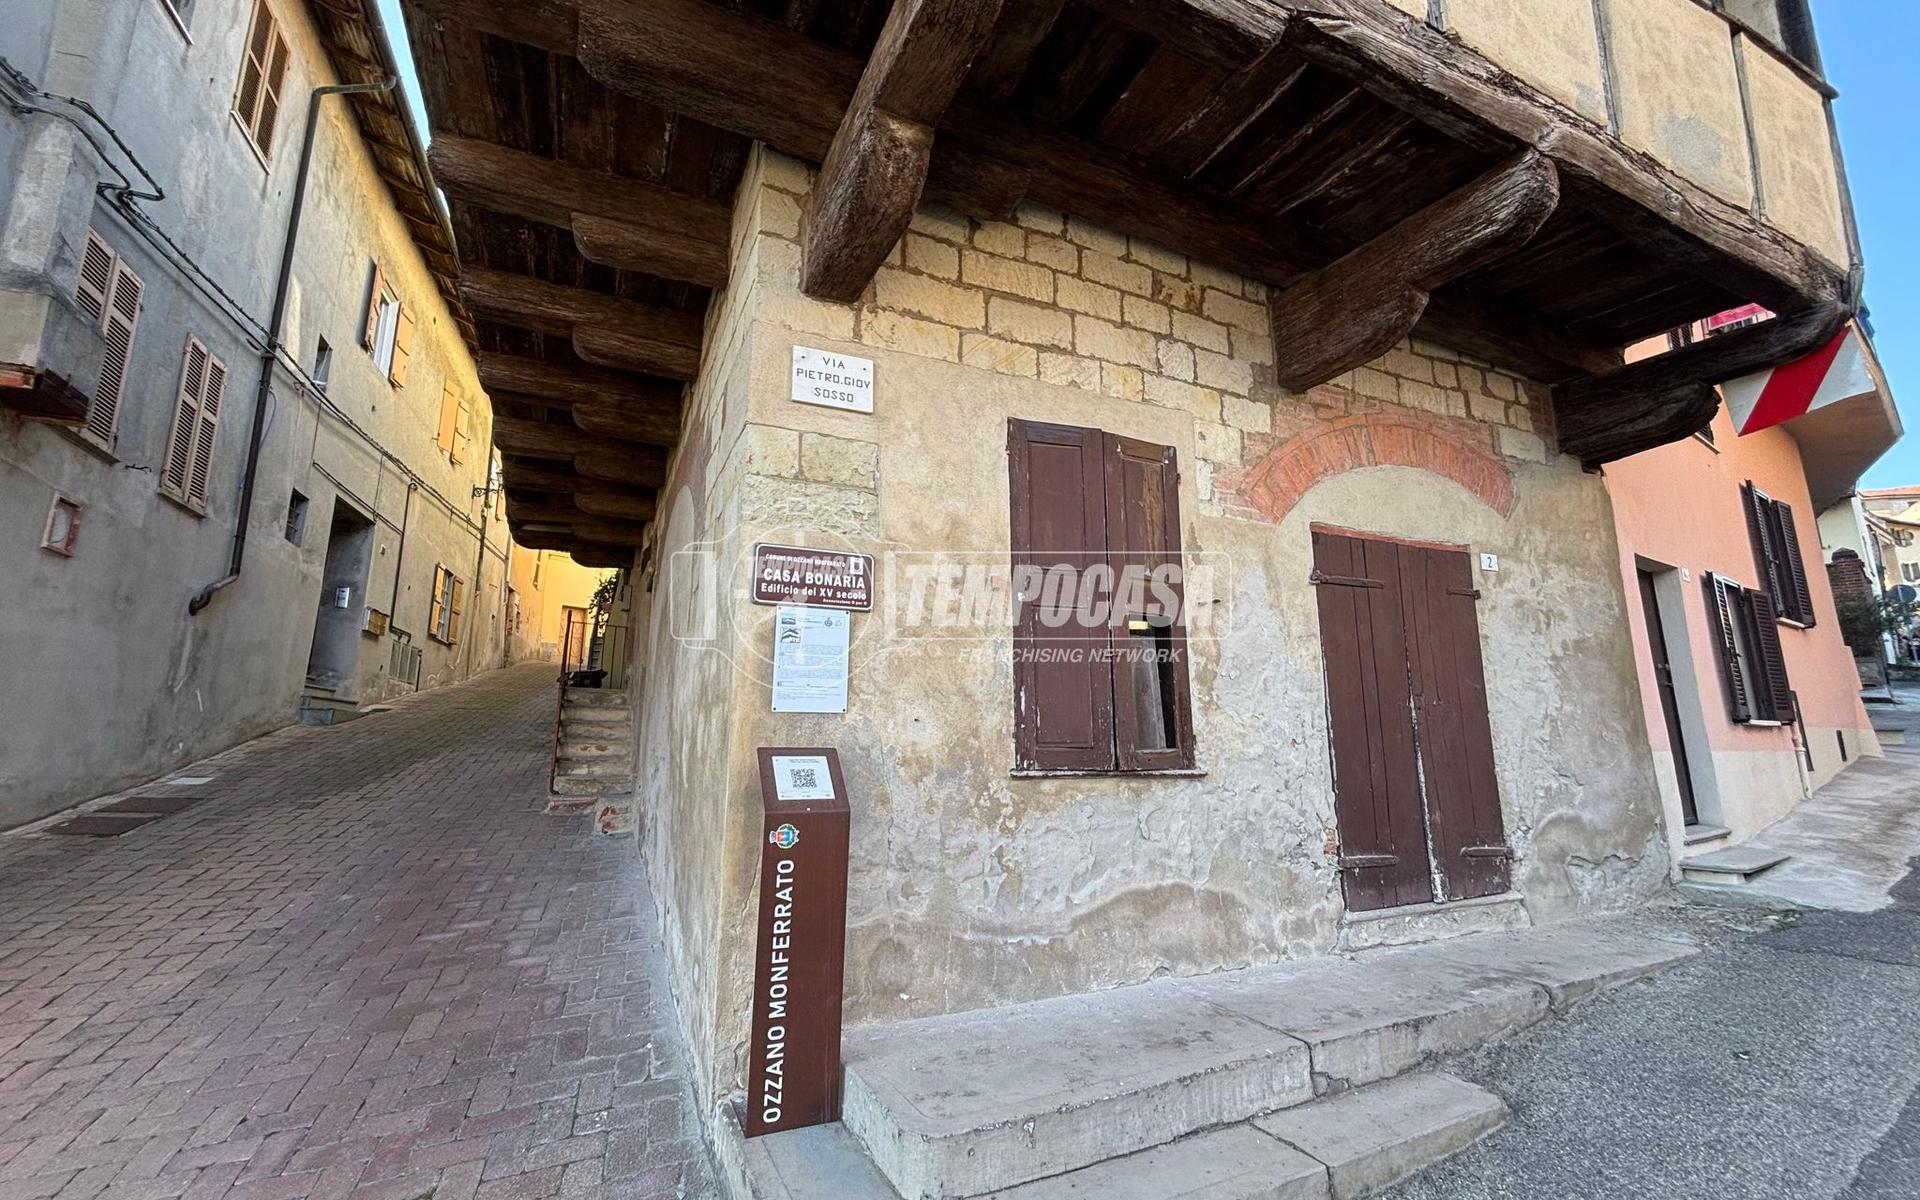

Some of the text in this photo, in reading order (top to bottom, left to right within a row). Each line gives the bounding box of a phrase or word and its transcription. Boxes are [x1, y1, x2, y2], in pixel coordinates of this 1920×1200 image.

[822, 356, 846, 370] VIA
[813, 387, 854, 403] SOSSO
[1487, 556, 1493, 568] 2
[763, 567, 865, 589] CASA BONARIA
[761, 582, 867, 600] Edificio del XV secolo
[763, 859, 795, 1123] OZZANO MONFERRATO
